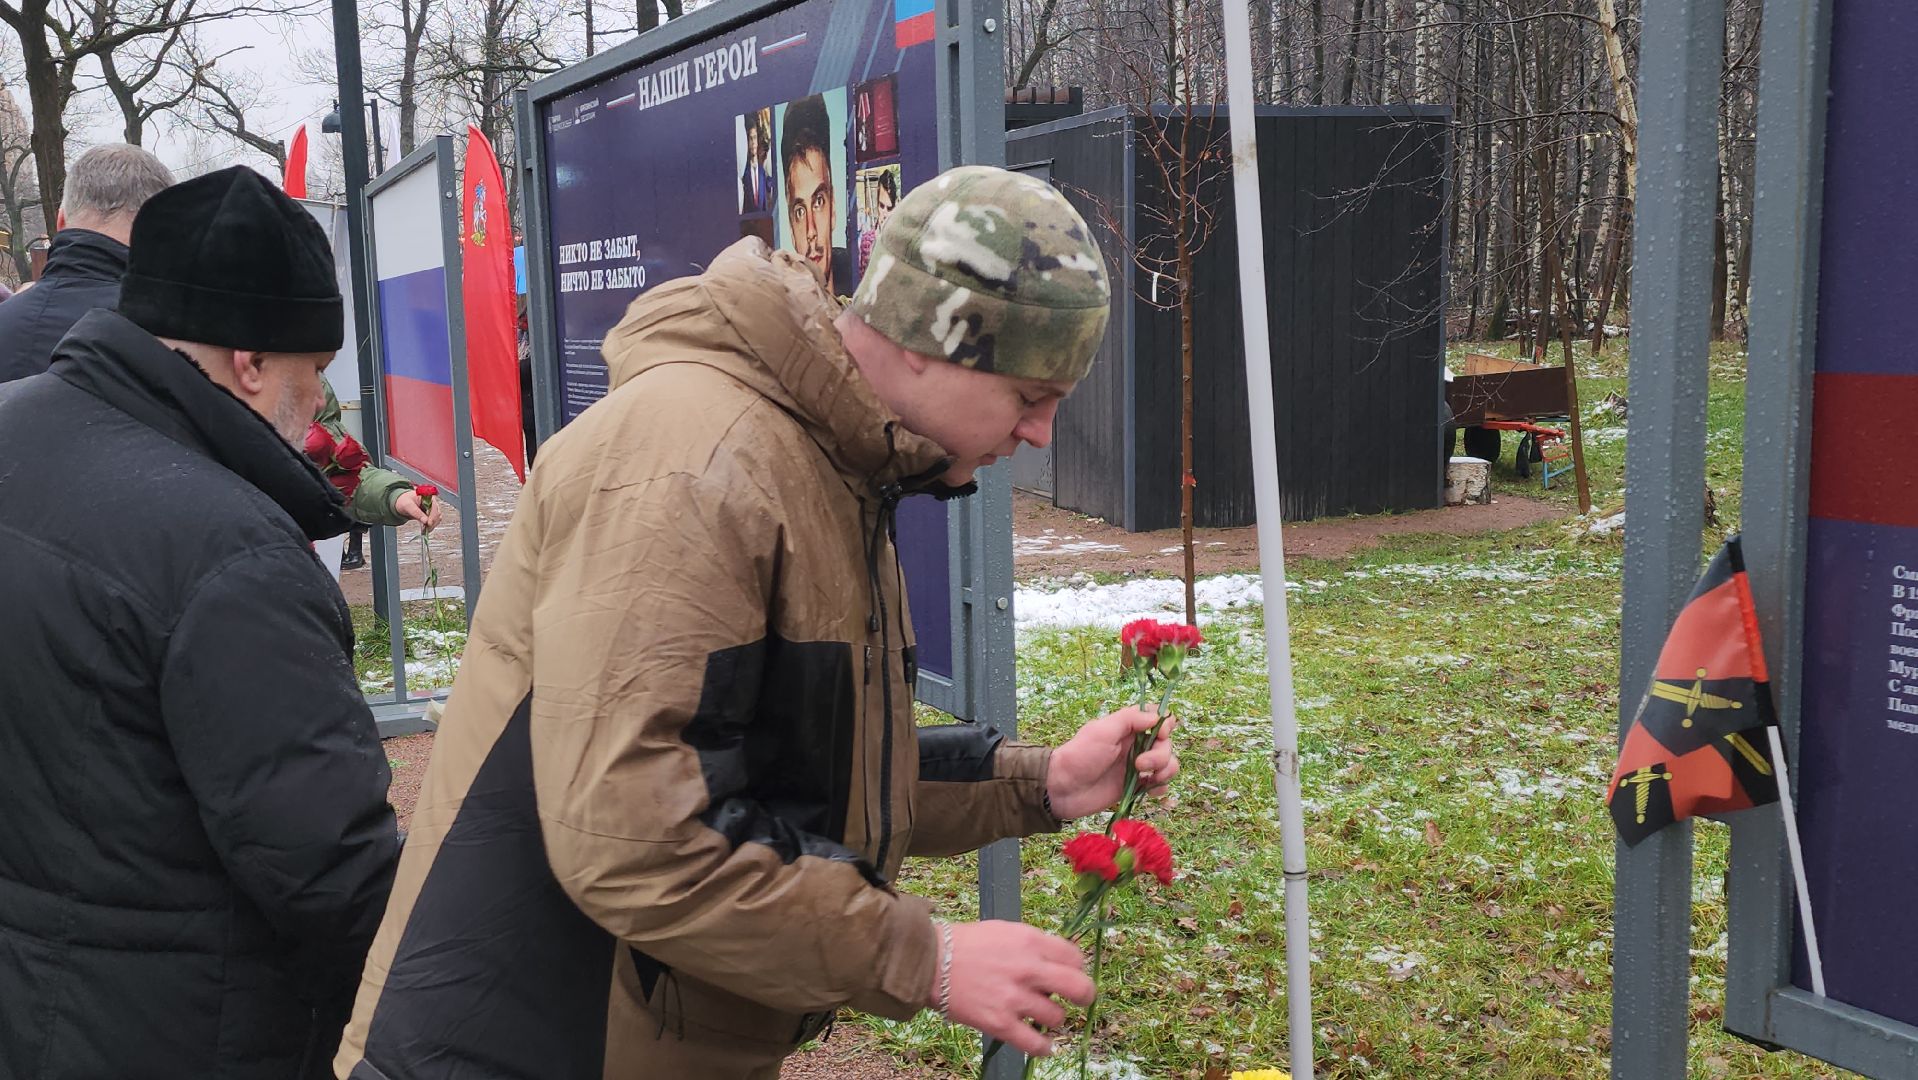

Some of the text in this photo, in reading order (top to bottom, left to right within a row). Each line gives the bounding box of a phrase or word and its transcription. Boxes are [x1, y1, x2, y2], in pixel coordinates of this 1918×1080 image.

[638, 36, 758, 111] НАШИ ГЕРОИ
[559, 235, 641, 265] НИКТО НЕ ЗАБЫТ,
[560, 265, 646, 293] НИЧТО НЕ ЗАБЫТО
[1892, 584, 1906, 598] В
[1887, 679, 1901, 692] С
